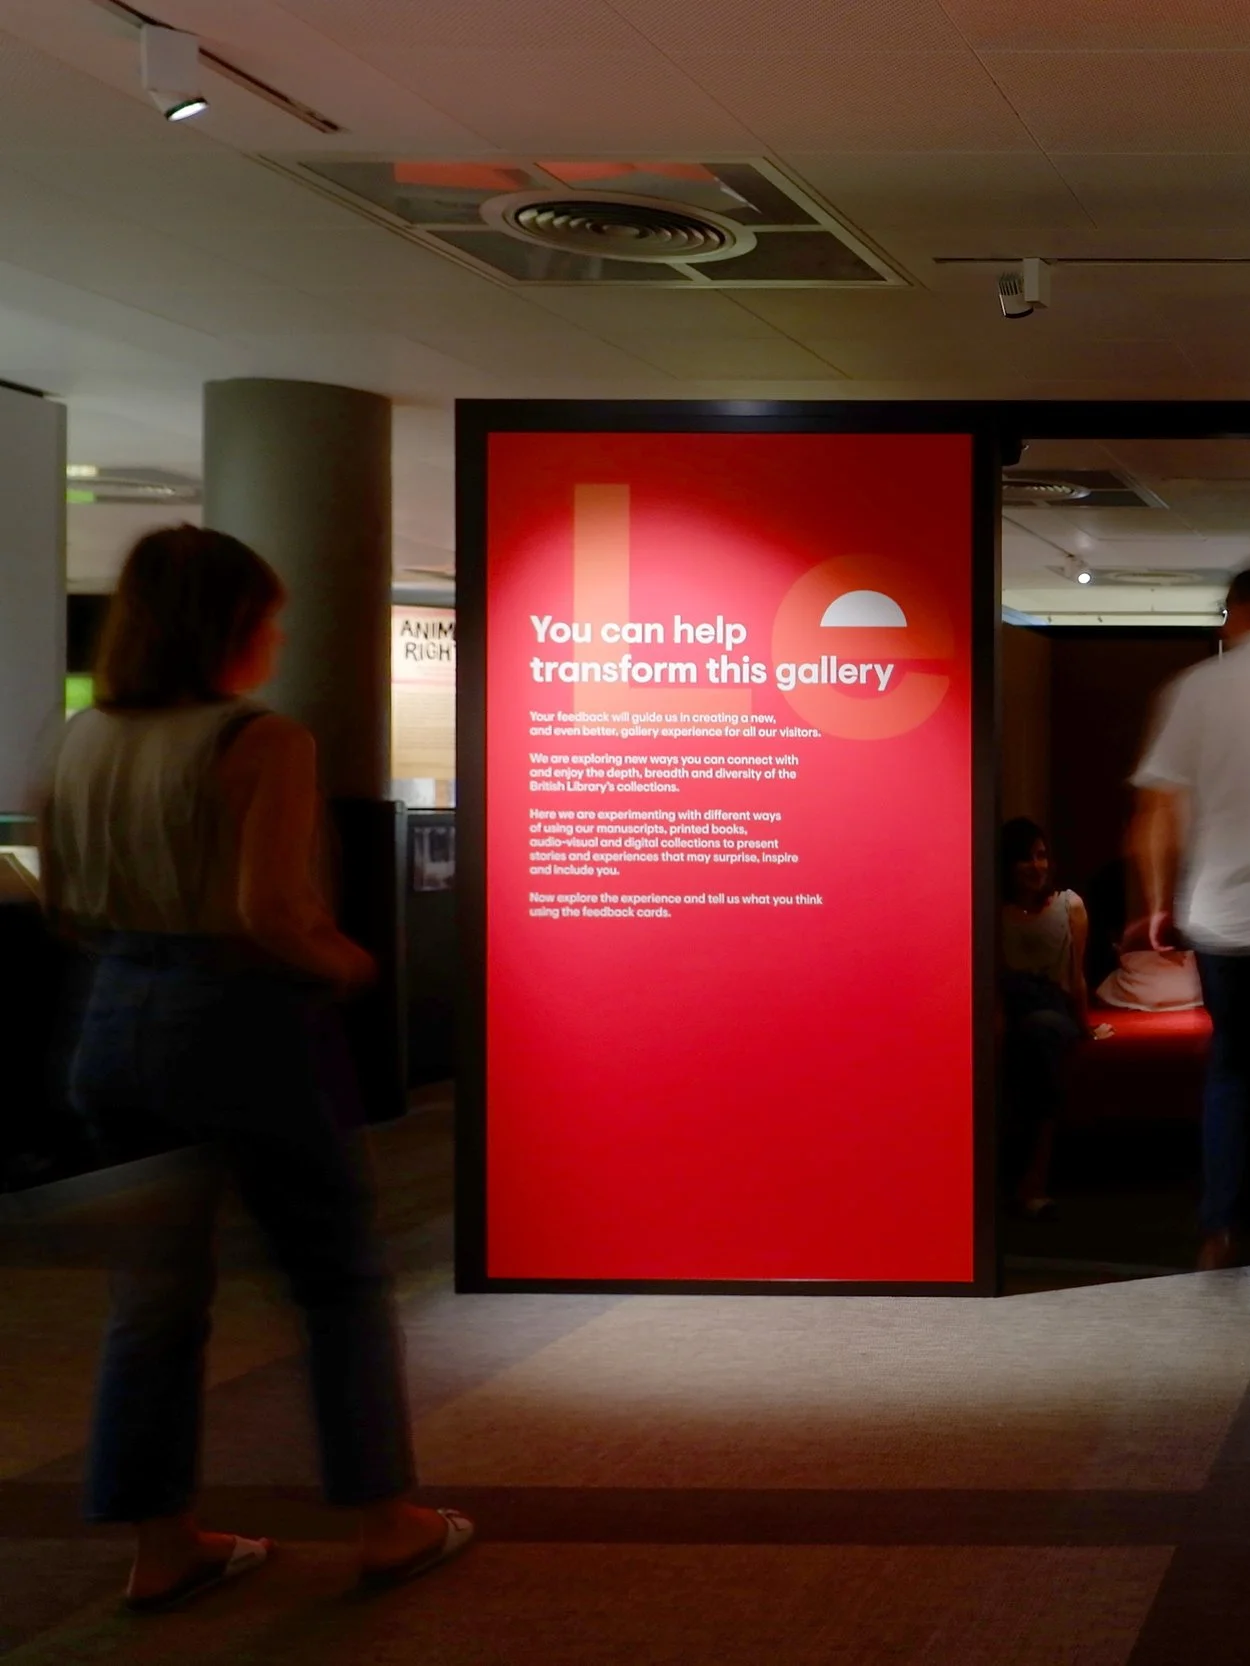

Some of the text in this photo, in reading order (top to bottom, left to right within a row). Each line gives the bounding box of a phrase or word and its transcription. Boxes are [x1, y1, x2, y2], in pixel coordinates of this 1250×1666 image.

[530, 615, 747, 651] You can help
[405, 641, 457, 661] RIGH
[530, 654, 894, 692] transform this gallery
[529, 711, 555, 722] Your
[557, 711, 609, 722] feedback
[611, 711, 630, 722] will
[631, 711, 663, 725] guide
[664, 714, 678, 723] us
[680, 712, 691, 723] in
[692, 712, 739, 725] creating
[740, 714, 749, 723] a
[529, 725, 552, 736] and
[553, 727, 581, 736] even
[620, 725, 659, 739] gallery
[661, 726, 723, 739] experience
[724, 726, 740, 737] for
[742, 726, 757, 737] all
[758, 728, 778, 737] our
[779, 726, 821, 738] visitors.
[529, 753, 799, 767] We are exploring new ways you can connect with
[529, 767, 552, 778] and
[553, 767, 584, 780] enjoy
[585, 767, 605, 778] the
[644, 767, 689, 779] breadth
[691, 768, 713, 779] and
[715, 768, 762, 781] diversity
[763, 768, 776, 779] of
[777, 768, 797, 779] the
[529, 780, 565, 792] British
[616, 781, 680, 792] collections.
[529, 808, 782, 823] Here we are experimenting with different ways
[529, 822, 542, 833] of
[543, 822, 574, 836] using
[575, 824, 595, 833] our
[669, 823, 710, 836] printed
[529, 836, 779, 851] audio-visual and digital collections to present
[529, 850, 567, 861] stories
[568, 850, 591, 861] and
[592, 850, 659, 864] experiences
[660, 851, 685, 862] that
[686, 853, 711, 864] may
[762, 851, 799, 865] inspire
[529, 864, 620, 878] and include you.
[529, 892, 823, 907] Now explore the experience and tell us what you think
[529, 906, 672, 919] using the feedback cards.
